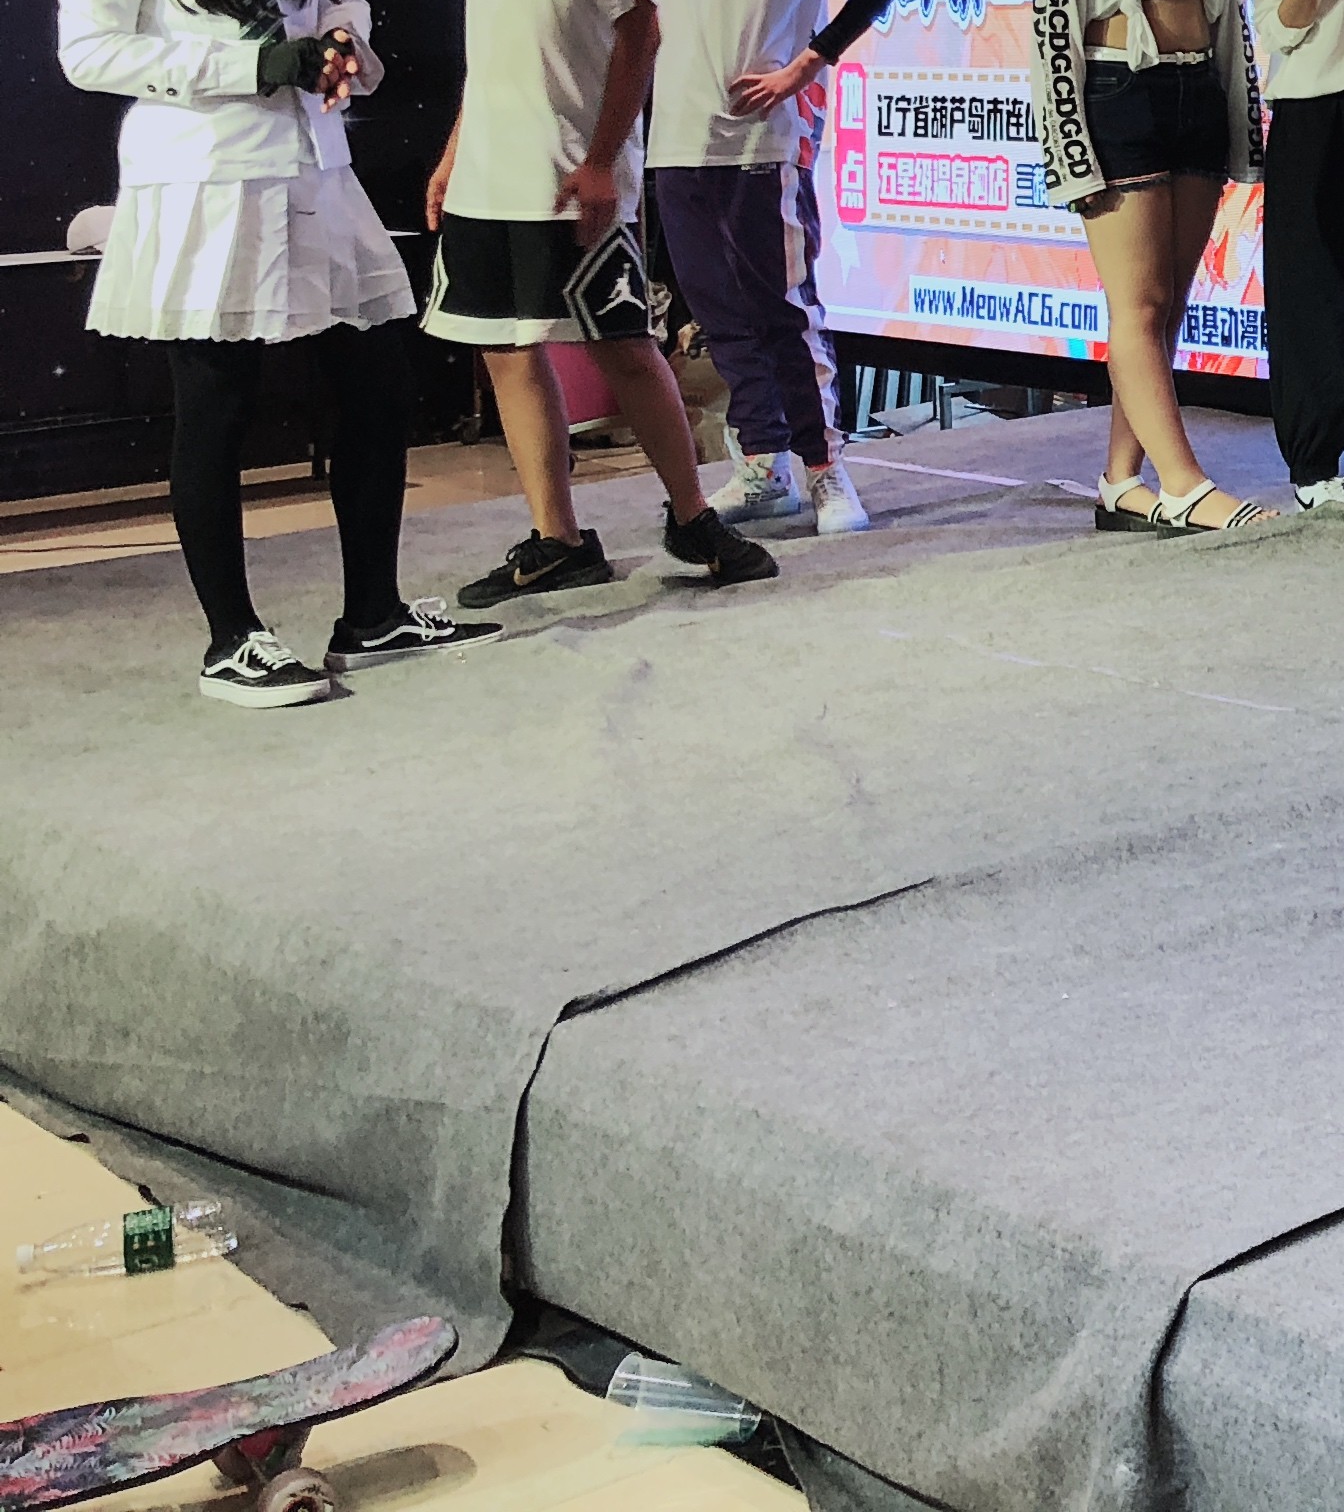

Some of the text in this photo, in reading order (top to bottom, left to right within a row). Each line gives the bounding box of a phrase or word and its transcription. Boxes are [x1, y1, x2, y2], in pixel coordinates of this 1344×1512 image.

[840, 73, 864, 209] 地点
[880, 158, 1008, 208] 五星级温泉酒店
